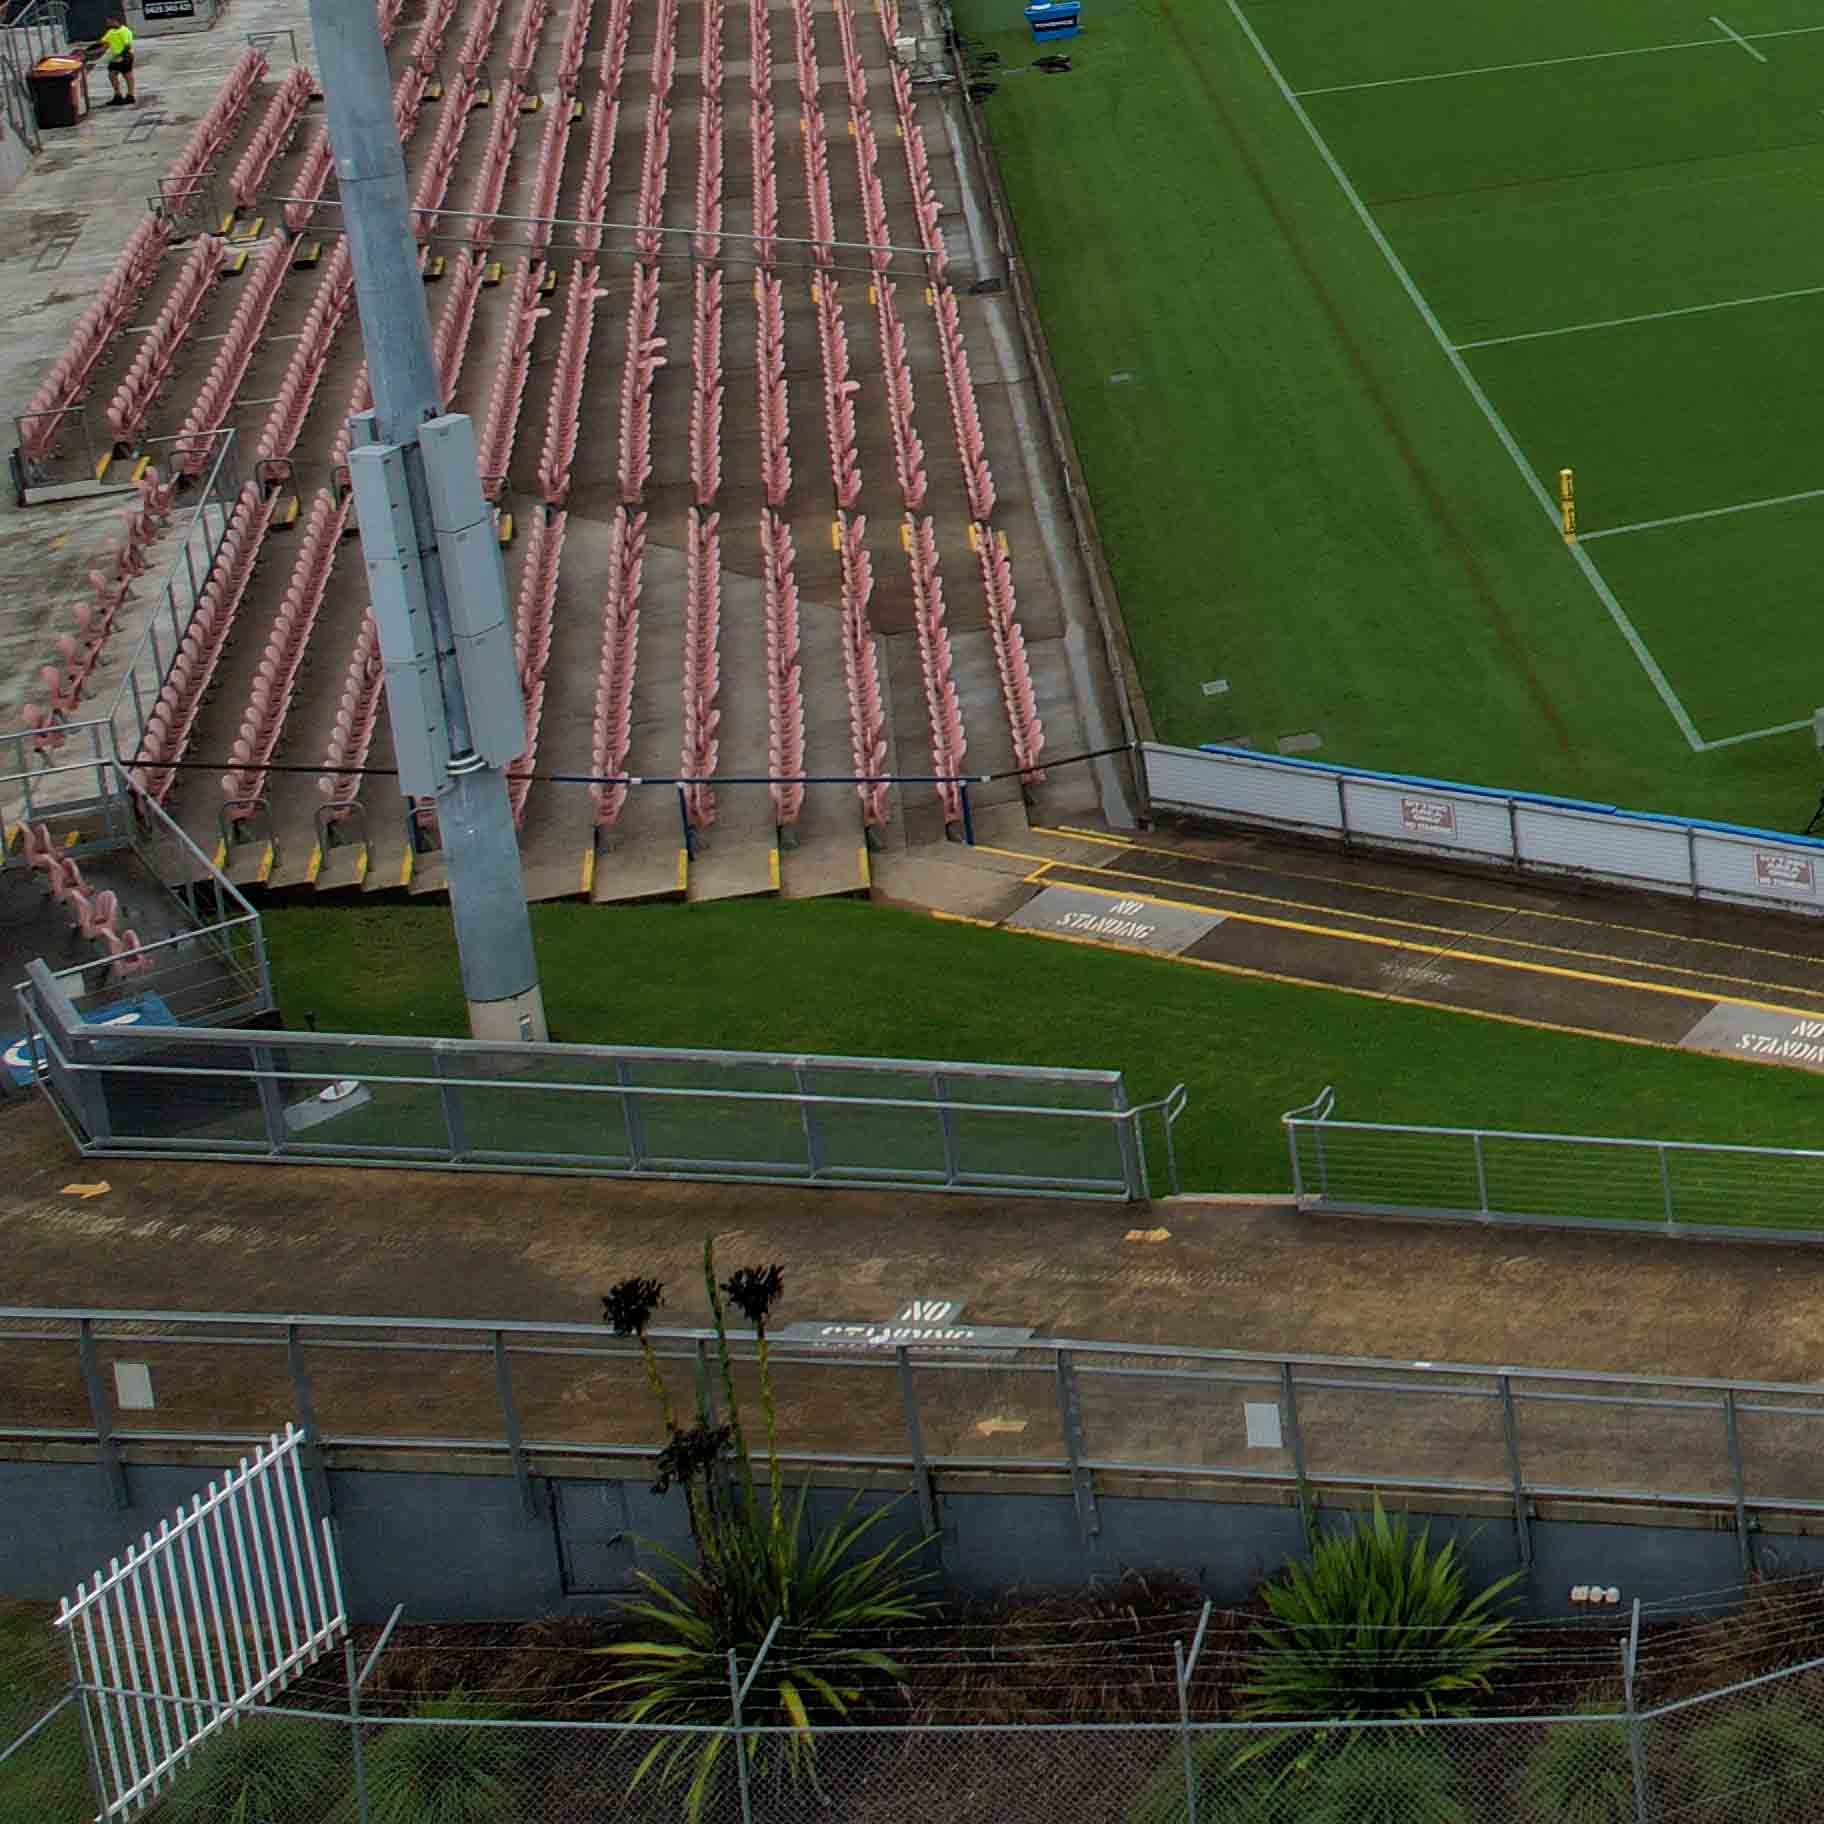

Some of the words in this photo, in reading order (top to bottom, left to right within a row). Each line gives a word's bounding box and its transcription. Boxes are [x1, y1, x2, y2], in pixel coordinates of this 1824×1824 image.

[1110, 899, 1145, 915] NO
[1056, 911, 1155, 940] STANDING
[900, 1300, 952, 1321] NO
